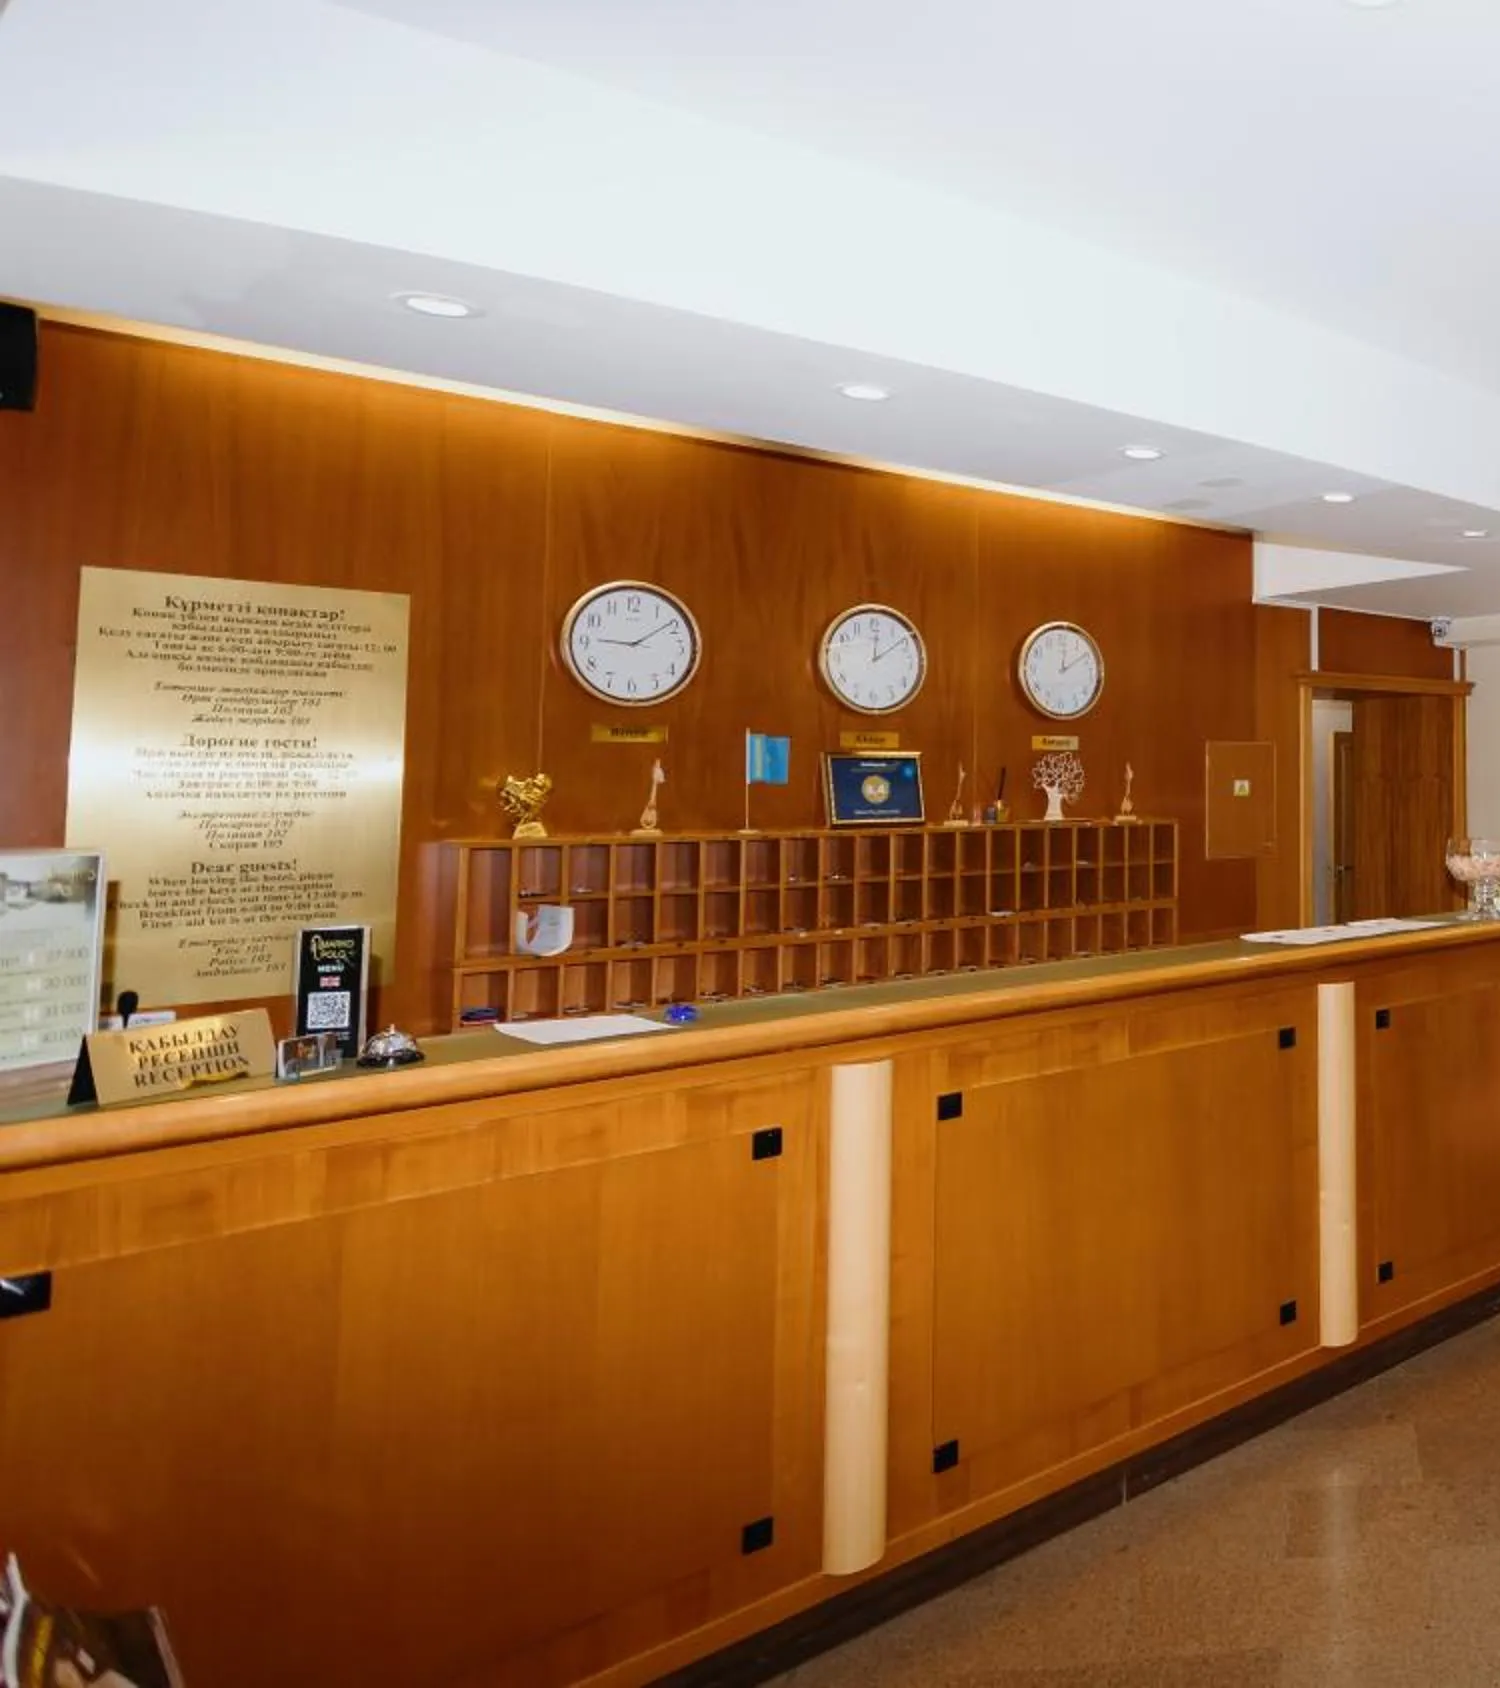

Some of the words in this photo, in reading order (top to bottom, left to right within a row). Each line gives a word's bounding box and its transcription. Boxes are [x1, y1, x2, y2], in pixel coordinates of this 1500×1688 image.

[607, 600, 617, 616] 11
[627, 596, 641, 612] 12
[587, 614, 601, 628] 10
[191, 861, 235, 875] Dear
[238, 858, 298, 876] guests!
[134, 1055, 250, 1089] RECEPTION
